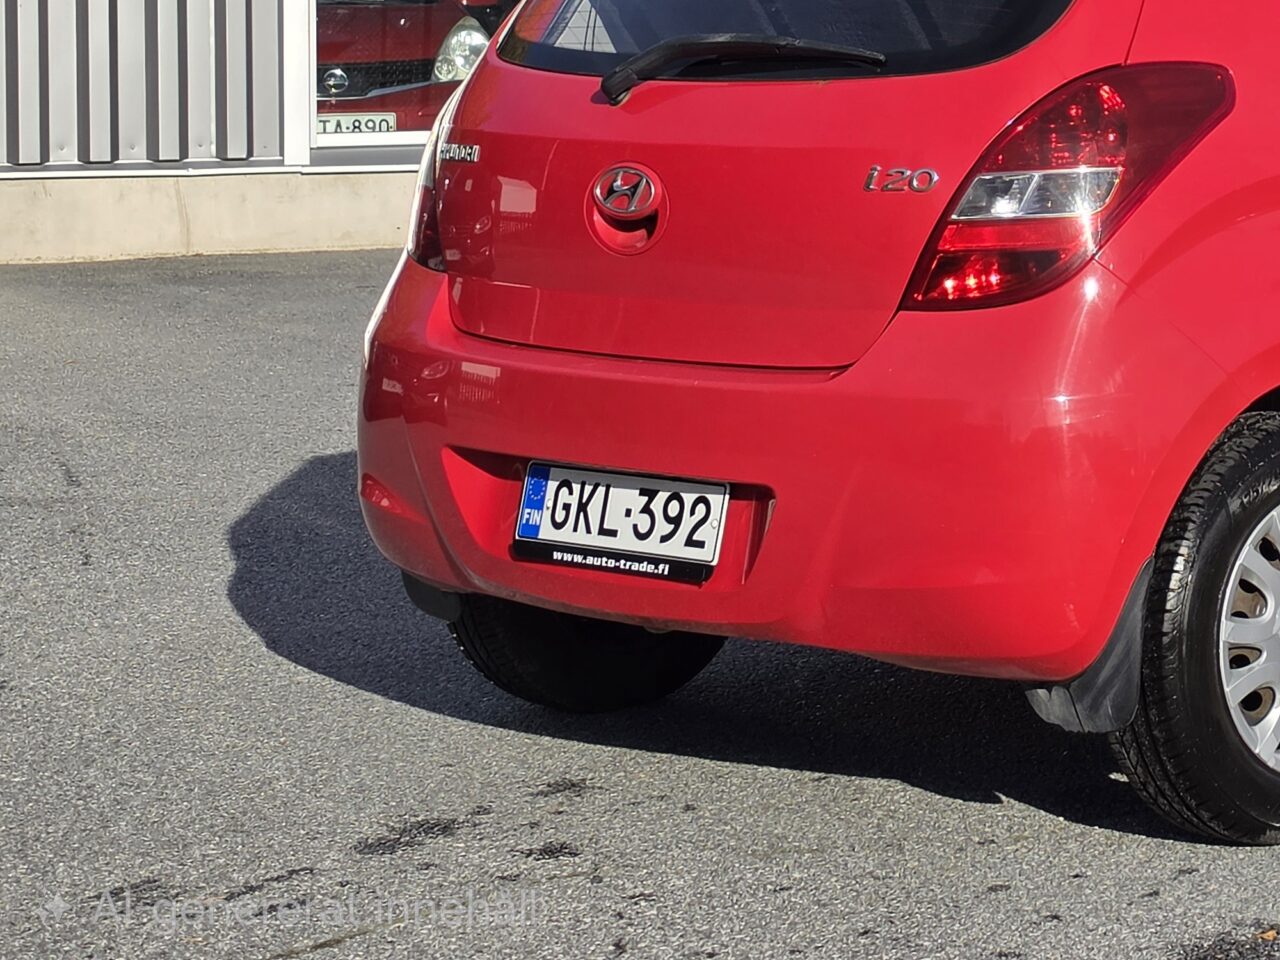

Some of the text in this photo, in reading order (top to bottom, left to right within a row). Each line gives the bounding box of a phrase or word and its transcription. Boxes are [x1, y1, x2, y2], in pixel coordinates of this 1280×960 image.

[864, 165, 940, 192] i20
[521, 507, 542, 527] FIN
[550, 478, 712, 550] GKL-392
[552, 550, 669, 575] www.auto-trade.fi
